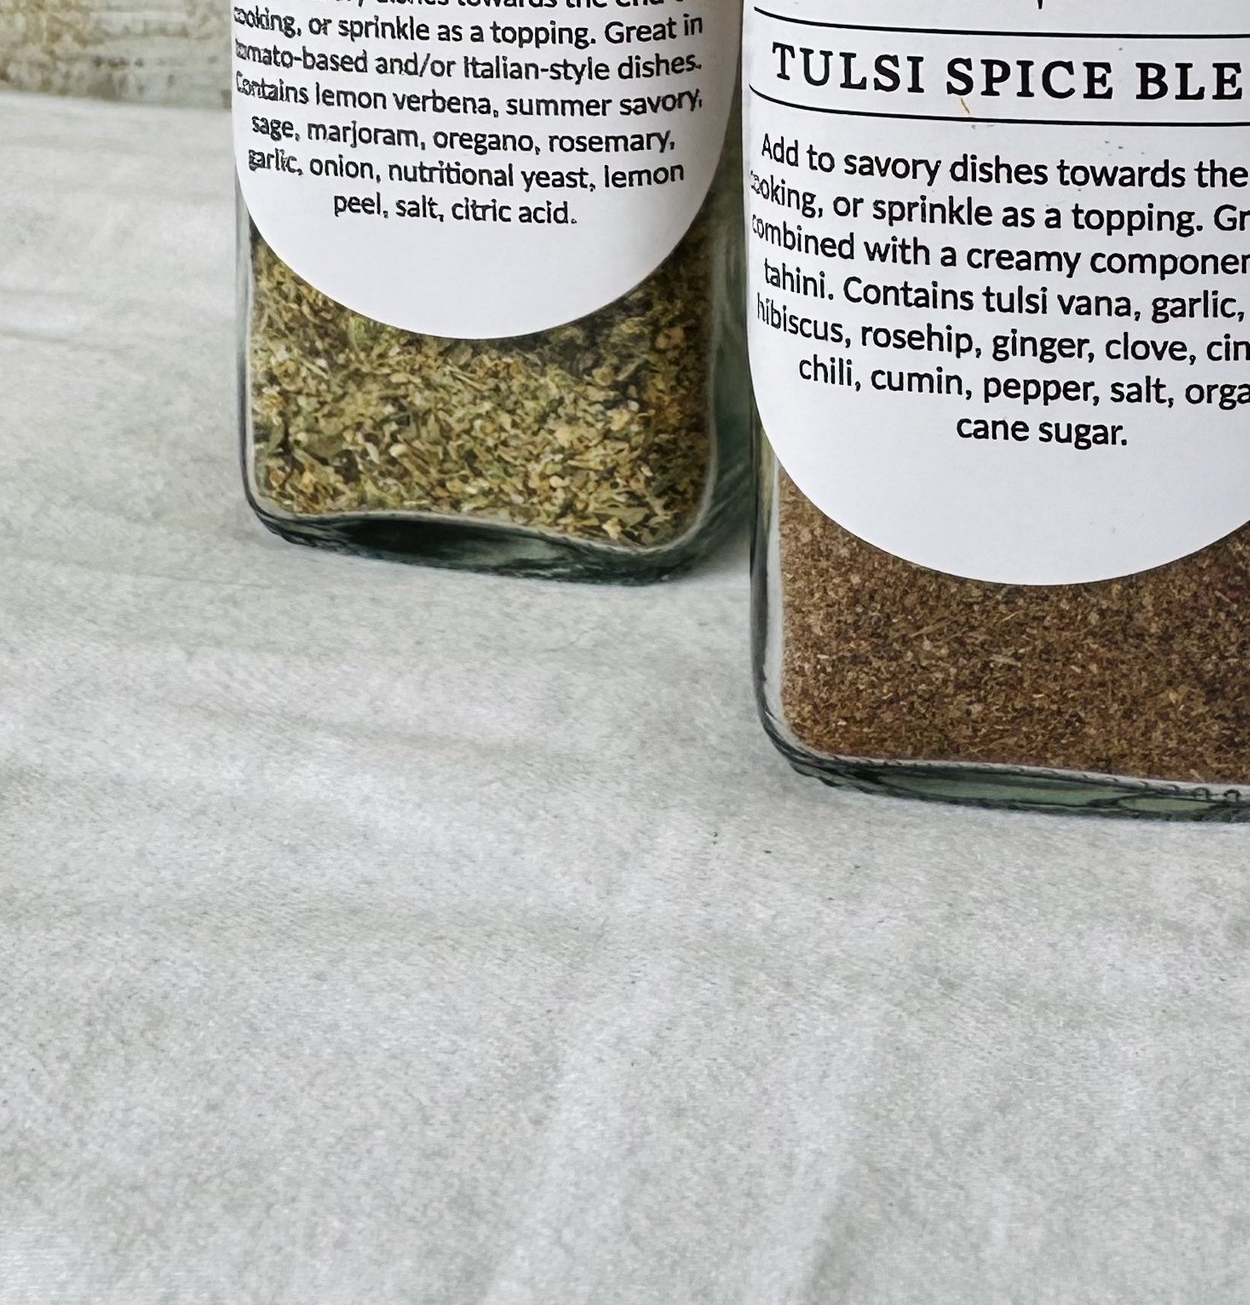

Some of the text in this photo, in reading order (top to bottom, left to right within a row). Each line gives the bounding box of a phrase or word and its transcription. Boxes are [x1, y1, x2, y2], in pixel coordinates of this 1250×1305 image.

[307, 16, 333, 37] or
[337, 14, 431, 43] sprinkle
[436, 23, 464, 43] as
[469, 24, 485, 43] a
[488, 19, 597, 51] topping.
[603, 16, 678, 45] Great
[682, 12, 704, 37] in
[374, 51, 457, 78] and/or
[462, 54, 611, 86] Italian-style
[617, 52, 702, 80] dishes.
[771, 40, 925, 94] TULSI
[945, 57, 1114, 100] SPICE
[314, 81, 388, 111] lemon
[391, 88, 500, 119] verbena,
[505, 97, 613, 118] summer
[619, 88, 703, 116] savory,
[251, 115, 676, 156] sage, marjoram, oregano, rosemary,
[309, 153, 382, 185] onion,
[387, 159, 515, 188] nutritional
[520, 166, 597, 194] yeast,
[603, 163, 685, 189] lemon
[761, 132, 800, 168] Add
[805, 143, 836, 174] to
[843, 153, 943, 188] savory
[948, 152, 1049, 186] dishes
[1055, 158, 1187, 189] towards
[1193, 158, 1249, 189] the
[333, 190, 578, 225] peel, salt, citric acid.
[832, 195, 865, 219] or
[872, 194, 994, 228] sprinkle
[1001, 205, 1036, 229] as
[1043, 207, 1062, 230] a
[1070, 202, 1204, 239] topping.
[752, 214, 855, 261] combined
[862, 234, 931, 266] with
[939, 245, 958, 268] a
[966, 247, 1082, 279] creamy
[763, 257, 834, 301] tahini.
[842, 275, 975, 312] Contains
[981, 284, 1048, 315] tulsi
[1056, 293, 1142, 322] vana,
[1150, 289, 1245, 325] garlic,
[757, 292, 852, 349] hibiscus,
[860, 322, 982, 360] rosehip,
[991, 327, 1095, 365] ginger,
[1104, 330, 1197, 366] clove,
[798, 353, 862, 393] chili,
[870, 365, 973, 401] cumin,
[983, 376, 1101, 407] pepper,
[1109, 374, 1175, 409] salt,
[955, 417, 1128, 451] cane sugar.
